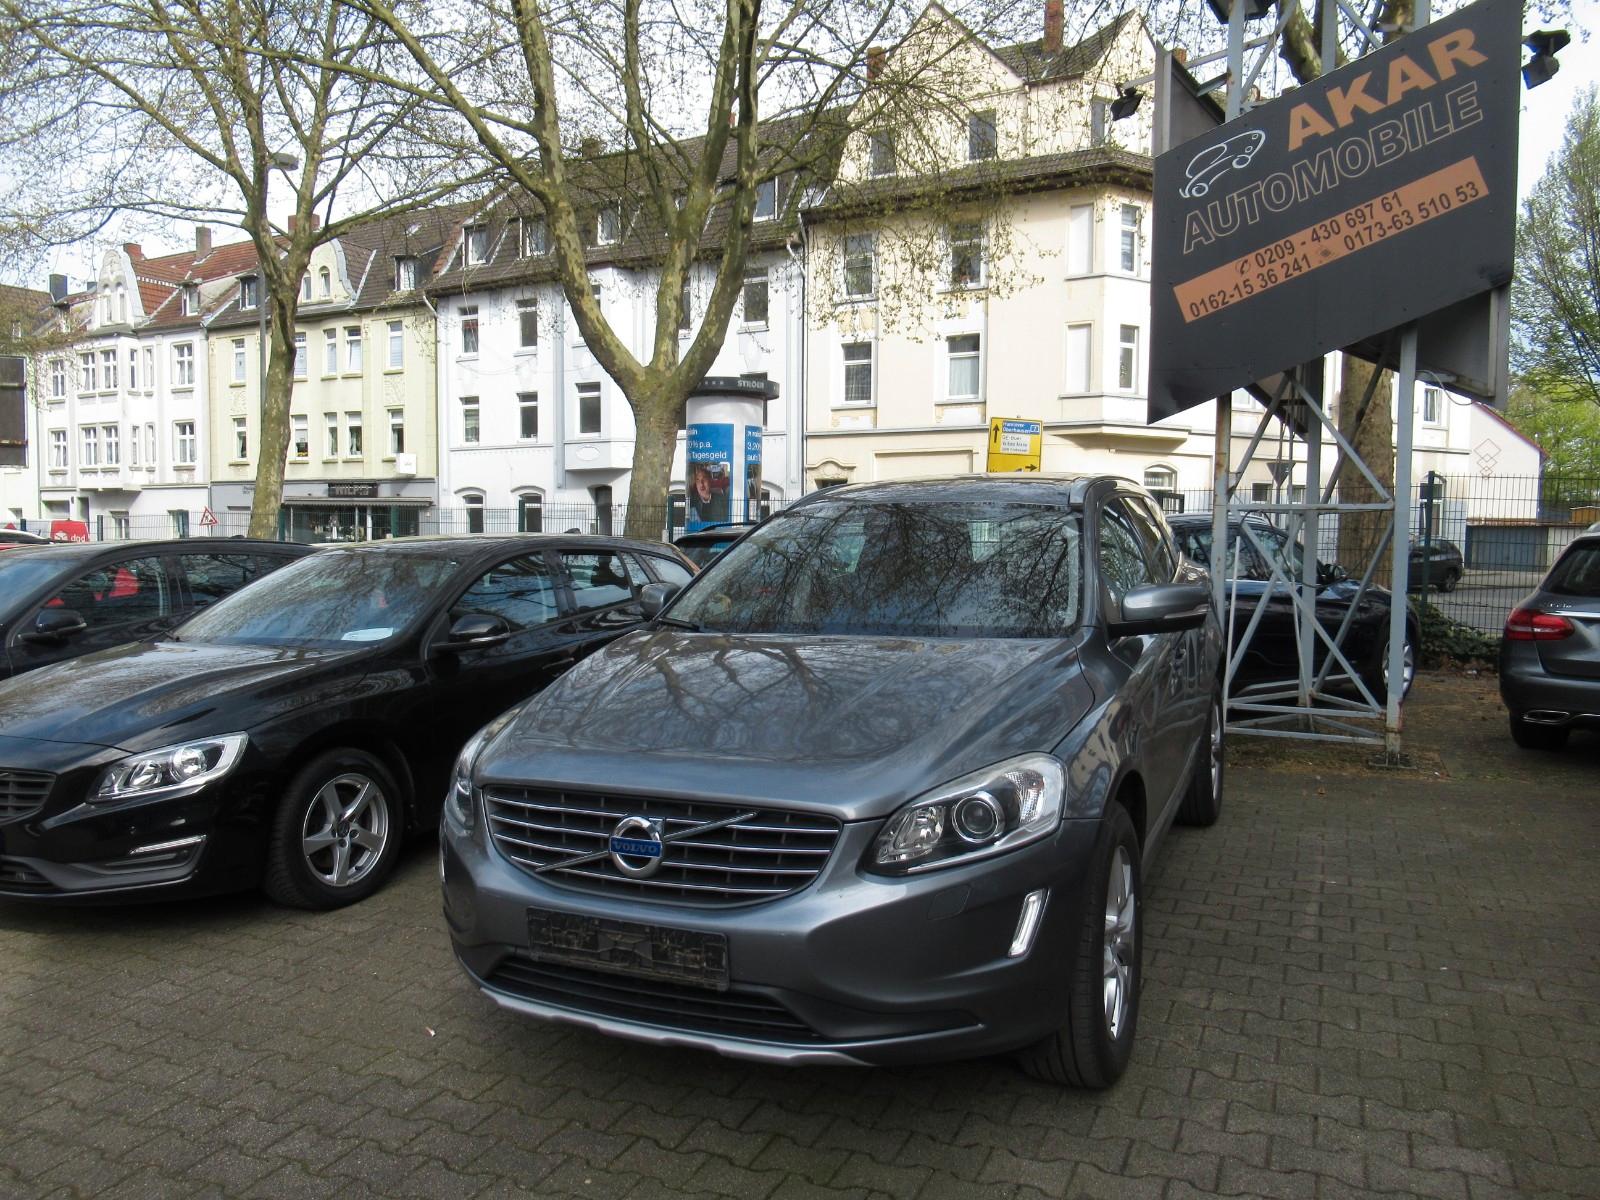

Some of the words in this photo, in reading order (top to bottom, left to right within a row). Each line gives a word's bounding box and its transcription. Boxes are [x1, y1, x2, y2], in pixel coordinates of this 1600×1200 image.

[1288, 28, 1488, 151] AKAR
[1183, 80, 1484, 254] AUTOMOBILE
[1189, 279, 1254, 318] 0162-15
[1257, 269, 1278, 289] 36
[1281, 253, 1312, 278] 241
[1344, 209, 1414, 251] 0173-63
[1418, 193, 1451, 220] 510
[1455, 181, 1479, 203] 53
[1255, 239, 1295, 268] 0209
[1311, 218, 1341, 243] 430
[1345, 203, 1375, 229] 697
[1381, 192, 1403, 213] 61
[614, 842, 658, 853] VOLVO
